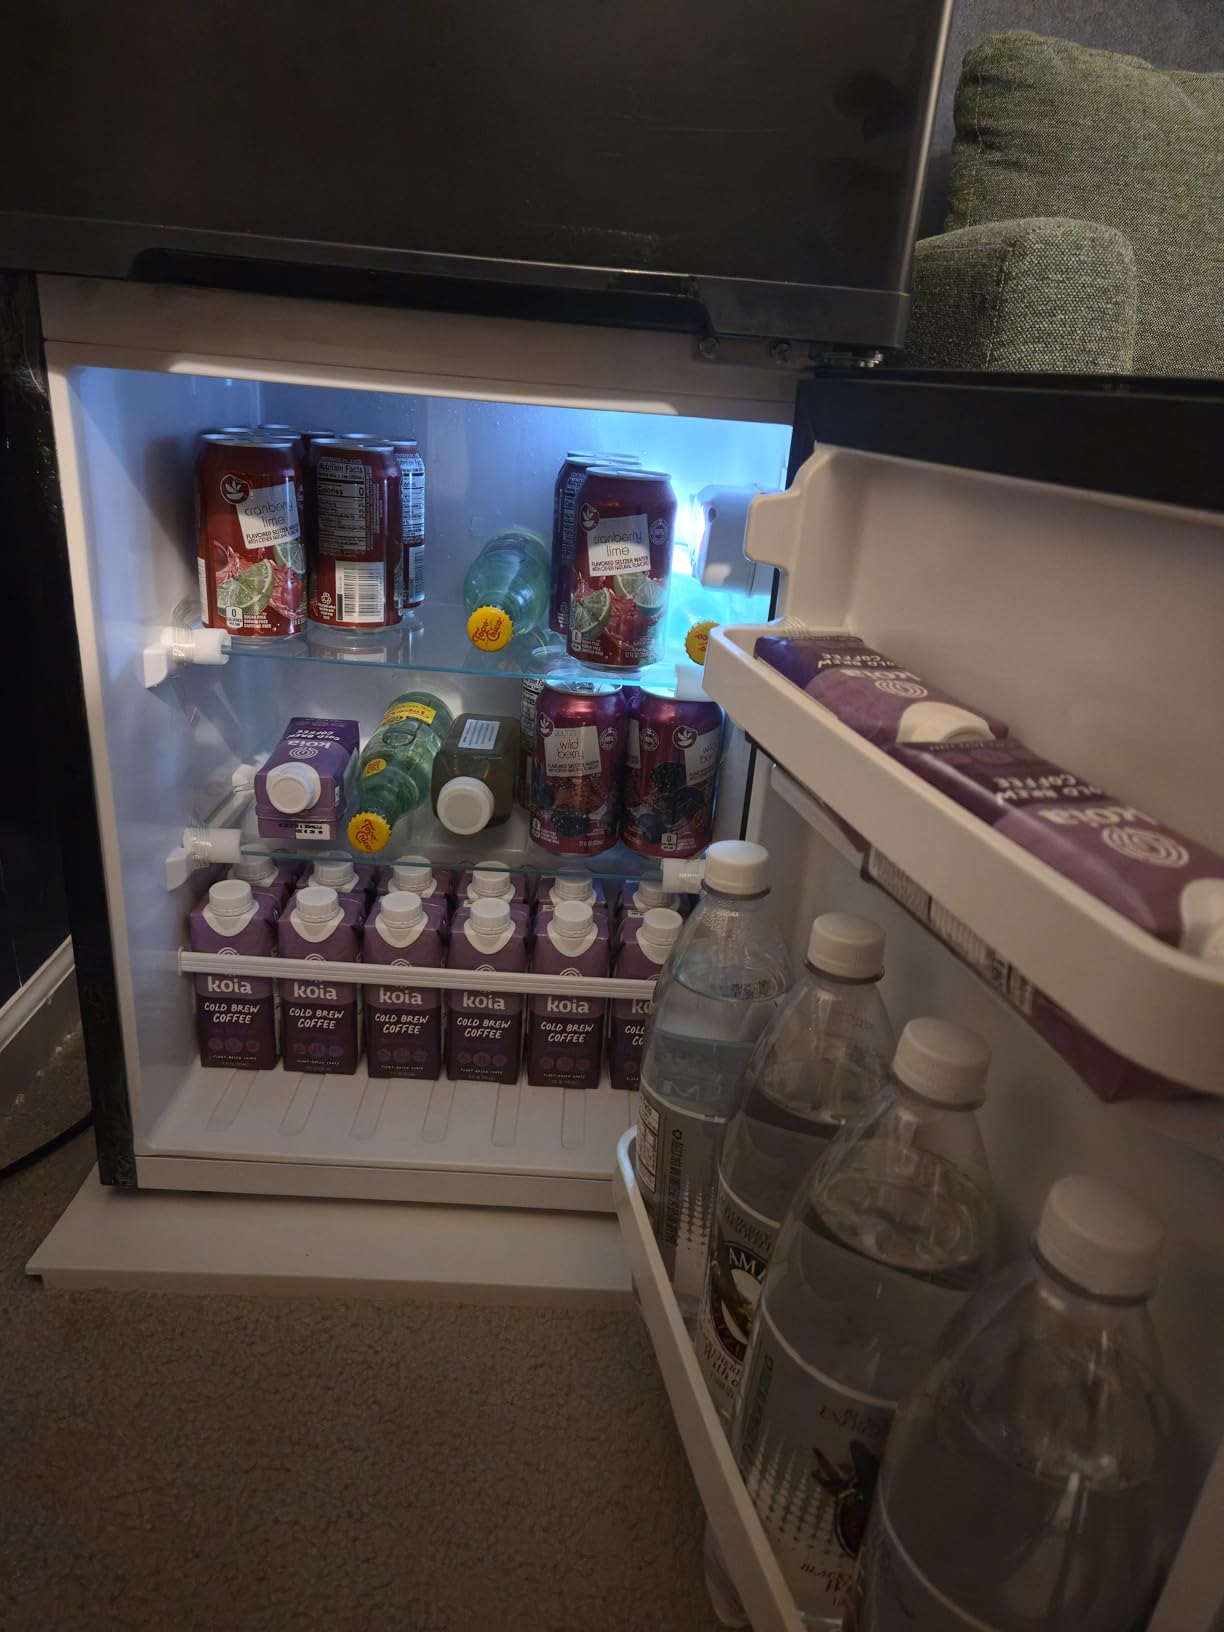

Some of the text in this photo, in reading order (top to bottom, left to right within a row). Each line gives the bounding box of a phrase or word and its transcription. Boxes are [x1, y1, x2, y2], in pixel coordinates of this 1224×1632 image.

[261, 516, 285, 527] lime
[592, 529, 642, 544] cranberry
[606, 545, 630, 557] lime
[472, 618, 488, 642] Topo
[486, 617, 502, 642] Chico
[822, 653, 880, 661] COFFEE
[840, 669, 920, 681] koia
[288, 740, 331, 749] koia
[993, 774, 1076, 788] COFFEE
[1063, 784, 1103, 797] OLD
[1038, 806, 1158, 828] koia
[208, 976, 253, 994] koia
[293, 982, 338, 1000] koia
[379, 987, 423, 1005] koia
[463, 992, 506, 1010] koia
[204, 1002, 260, 1013] COLD BREW
[546, 998, 589, 1014] koia
[631, 1000, 650, 1014] ko
[213, 1013, 252, 1024] COFFEE
[289, 1007, 344, 1019] COLD BREW
[375, 1013, 429, 1024] COLD BREW
[298, 1019, 336, 1029] COFFEE
[457, 1017, 511, 1029] COLD BREW
[540, 1021, 594, 1033] COLD BREW
[383, 1025, 421, 1035] COFFEE
[464, 1028, 502, 1039] COFFEE
[548, 1033, 585, 1043] COFFEE
